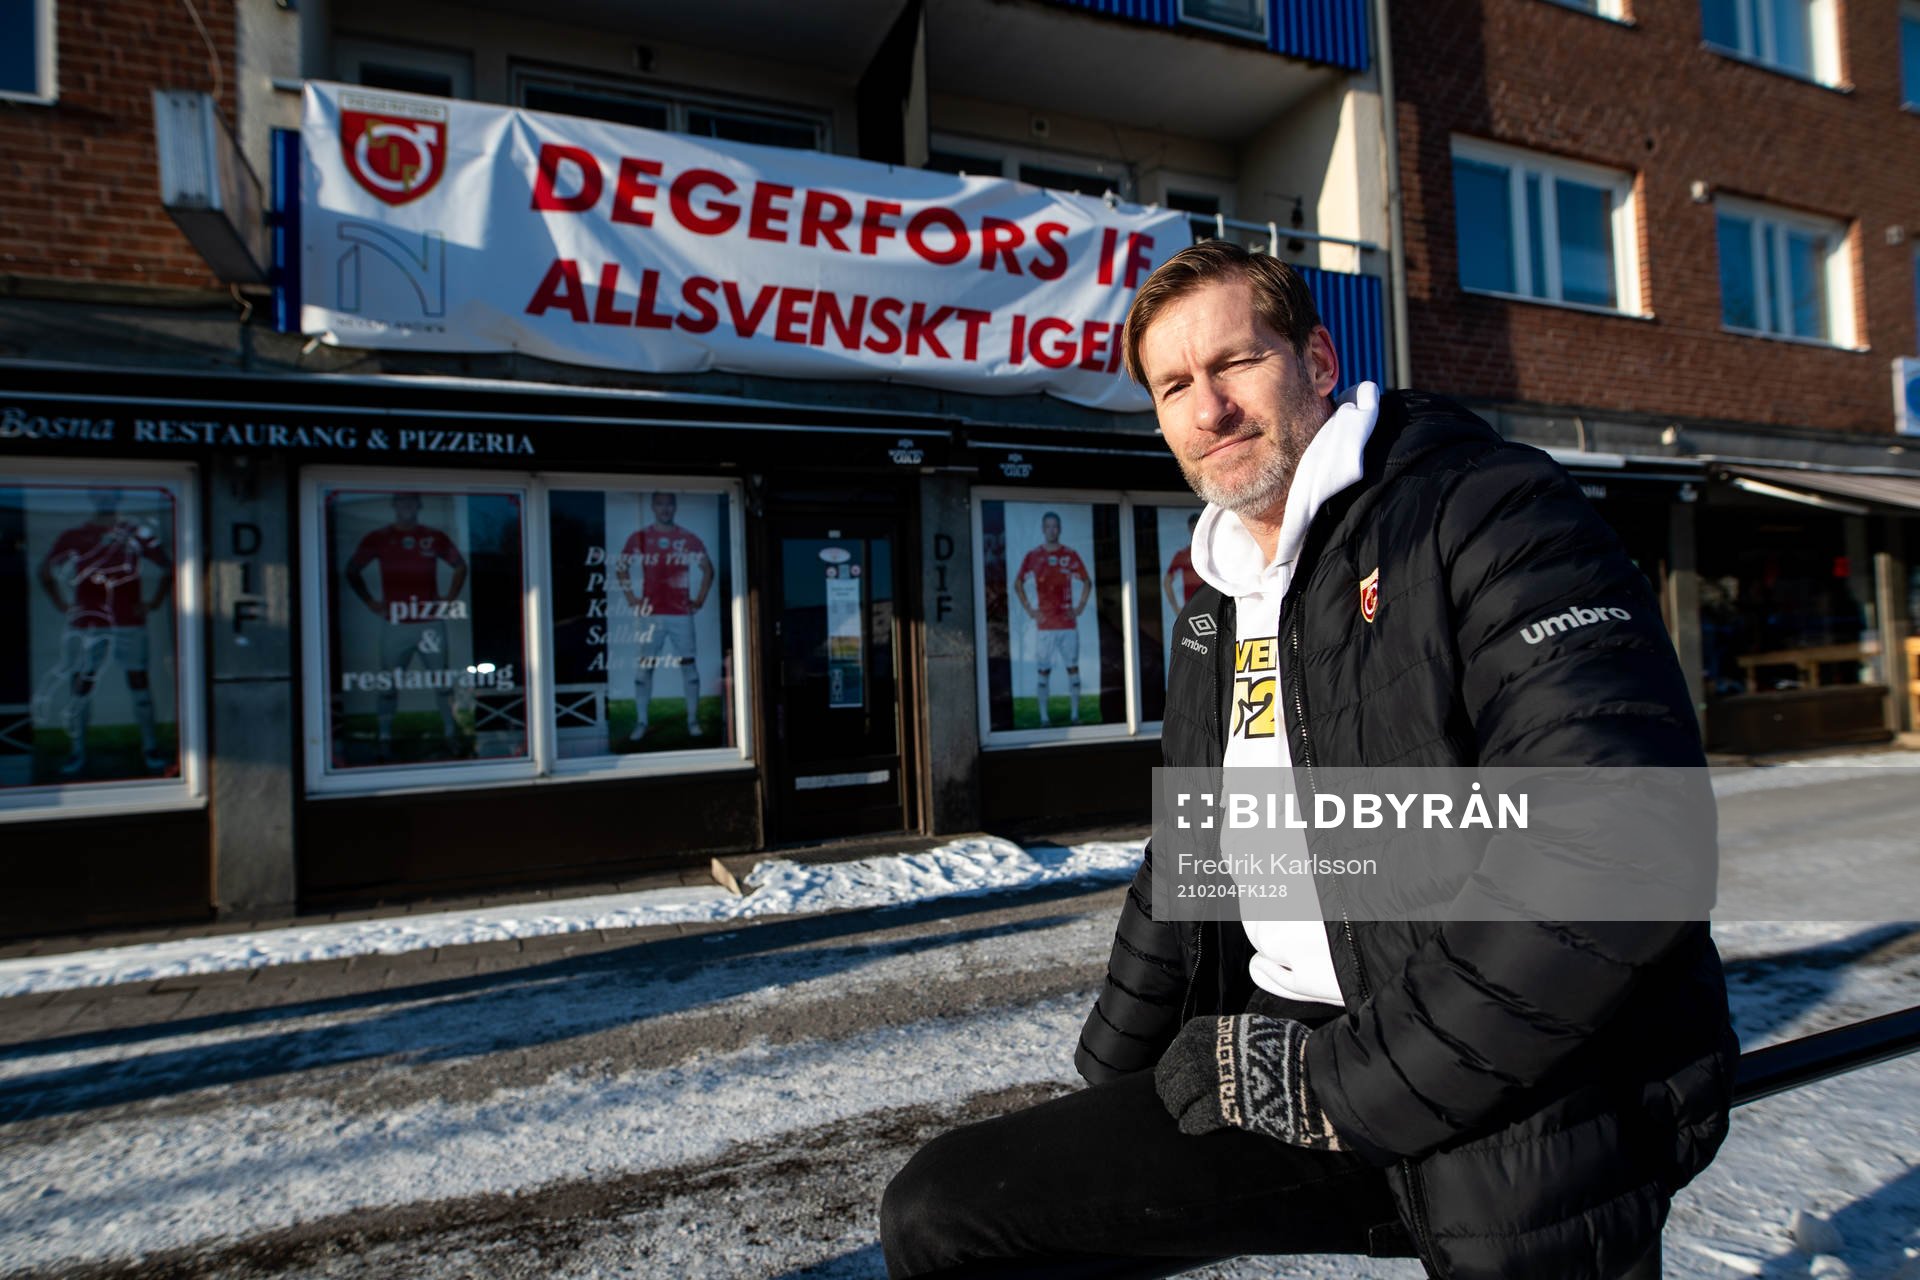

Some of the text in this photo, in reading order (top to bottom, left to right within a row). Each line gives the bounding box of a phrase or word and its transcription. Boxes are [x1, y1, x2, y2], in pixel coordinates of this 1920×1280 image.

[530, 143, 1155, 288] DEGERFORS IF
[525, 260, 990, 360] ALLSVENSKT
[0, 407, 536, 454] Bosna RESTAURANG & PIZZERIA
[389, 596, 468, 626] pizza
[1521, 606, 1632, 645] umbro
[418, 629, 441, 654] &
[1181, 636, 1208, 655] umbro
[341, 663, 515, 692] restaurang
